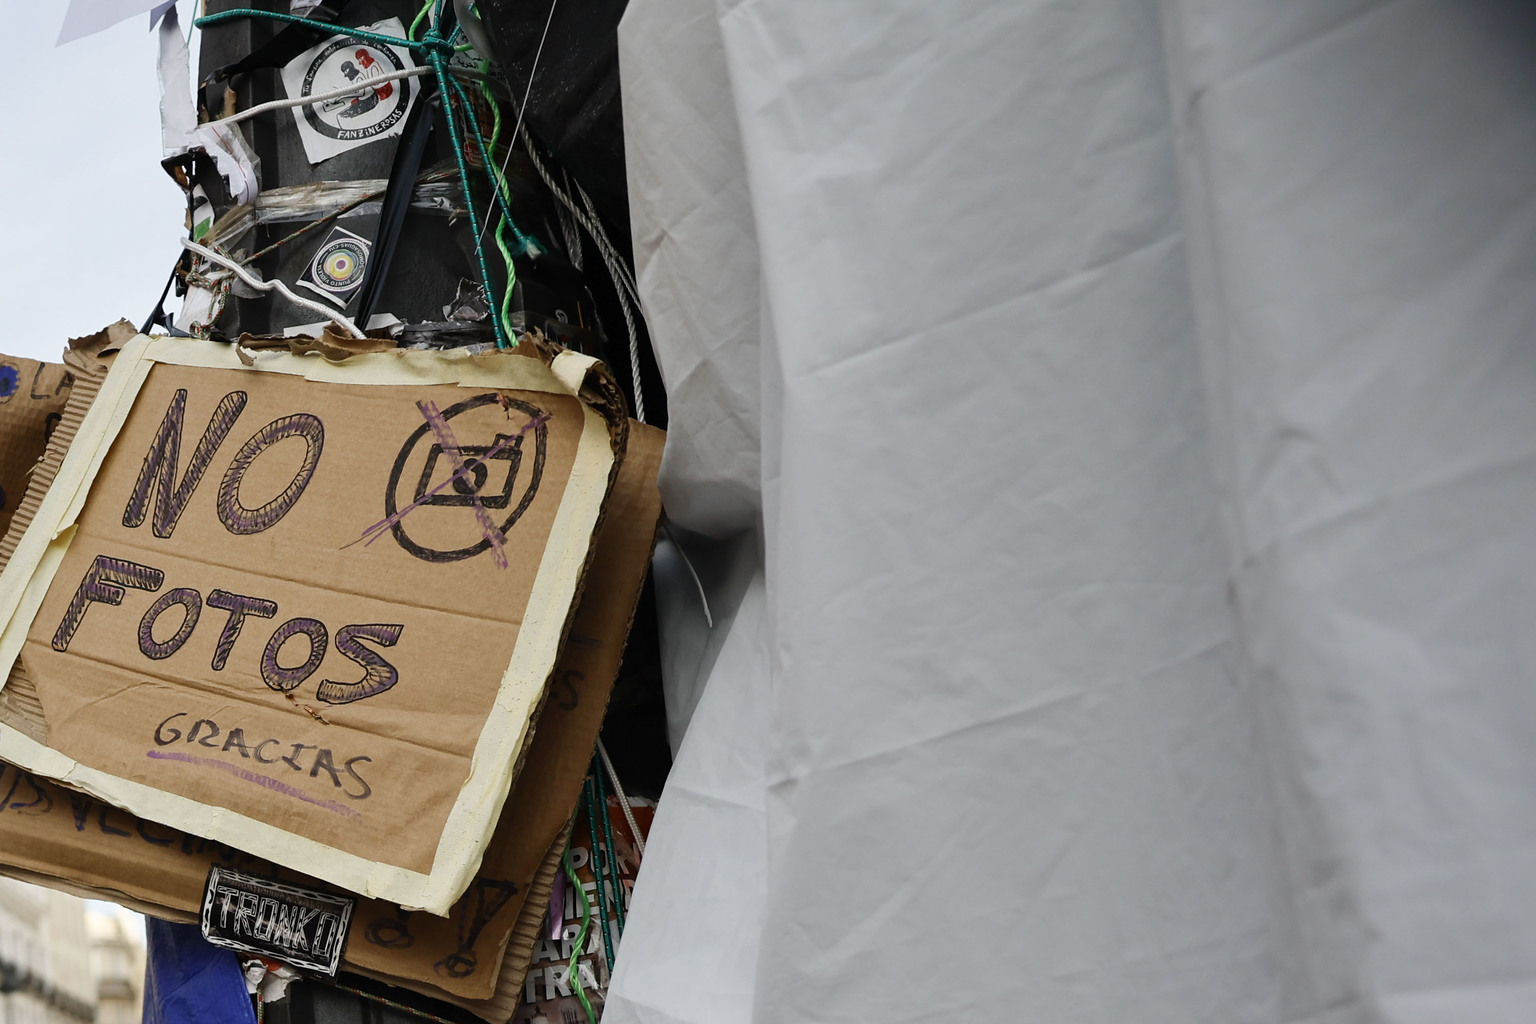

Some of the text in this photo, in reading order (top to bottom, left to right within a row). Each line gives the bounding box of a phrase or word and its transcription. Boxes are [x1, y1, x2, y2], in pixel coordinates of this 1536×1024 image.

[122, 388, 325, 538] NO
[51, 554, 404, 704] FOTOS
[154, 713, 373, 800] GRACIAS
[217, 885, 341, 962] TRONKO
